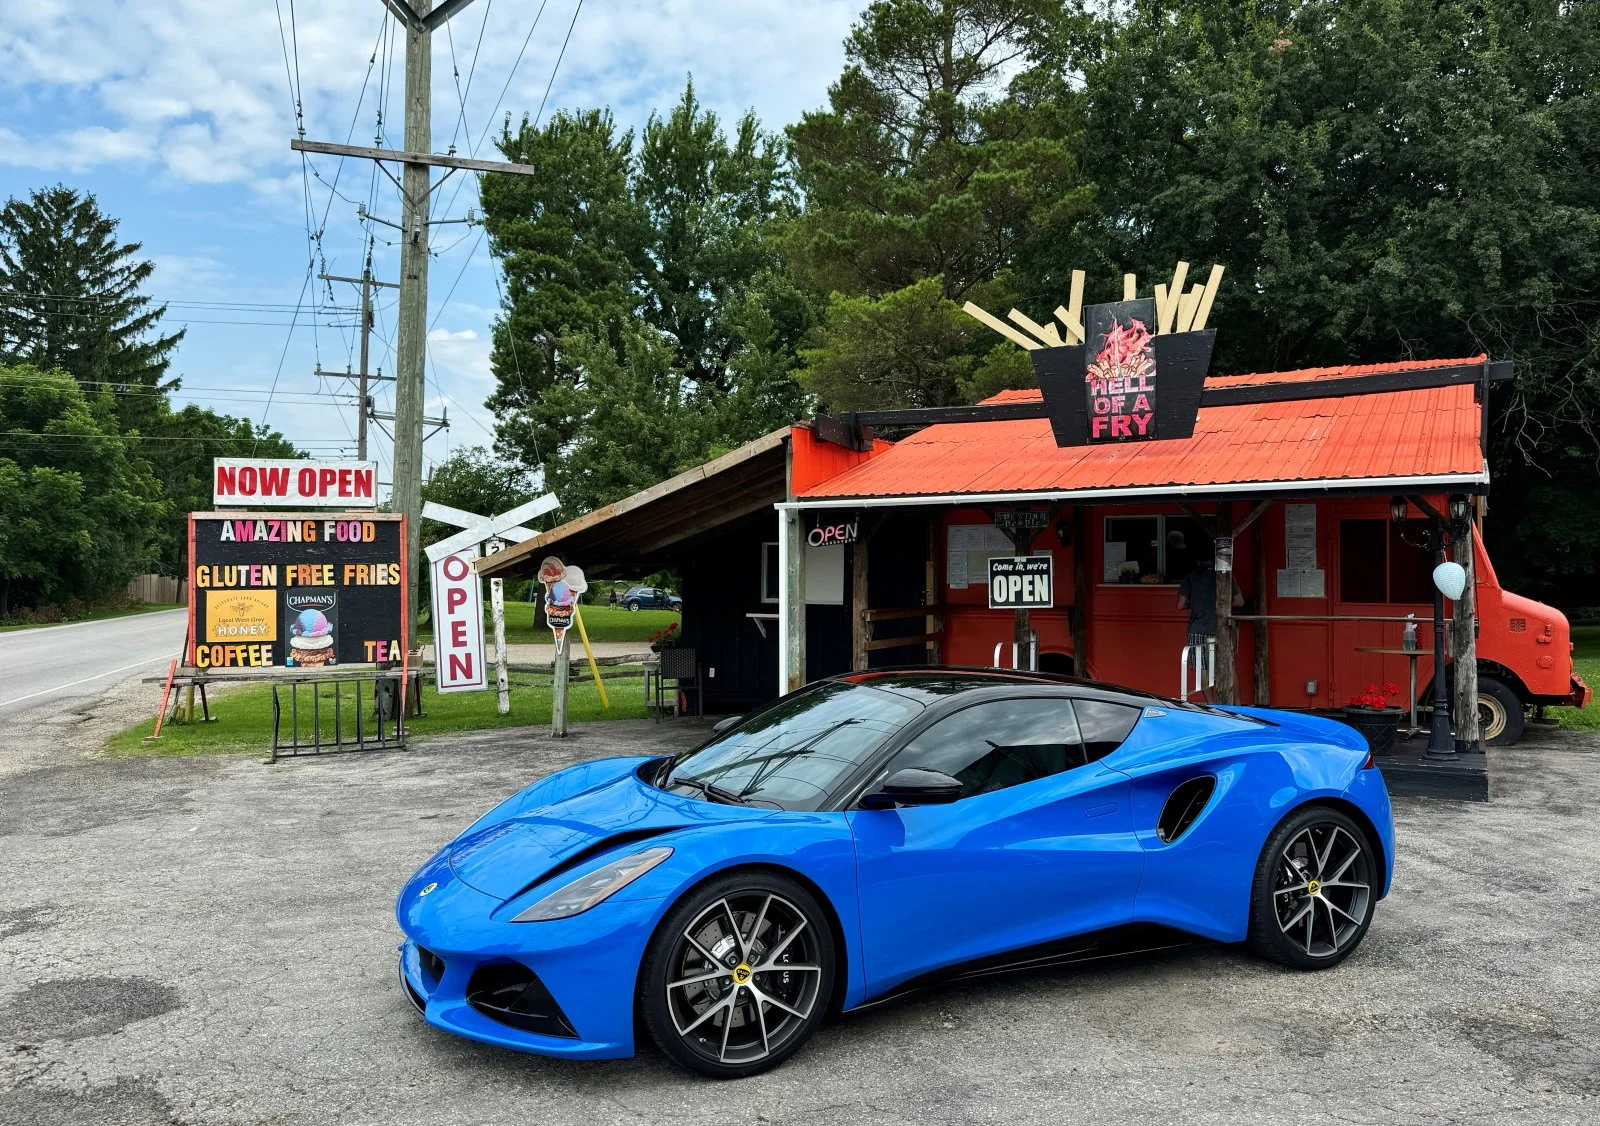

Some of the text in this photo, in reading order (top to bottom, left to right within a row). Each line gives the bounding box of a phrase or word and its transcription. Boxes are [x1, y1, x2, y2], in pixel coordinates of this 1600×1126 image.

[1091, 374, 1153, 396] HELL
[1093, 394, 1150, 414] OF A
[1092, 413, 1153, 438] FRY
[217, 466, 372, 498] NOW OPEN
[220, 520, 375, 542] AMAZING FOOD
[808, 522, 857, 546] OPEN
[196, 563, 401, 588] GLUTEN FREE FRIES
[992, 562, 1048, 571] Come in, we're
[289, 595, 333, 605] CHAPMAN'S
[993, 574, 1049, 603] OPEN
[218, 625, 266, 635] HONEY
[443, 555, 473, 681] OPEN
[196, 640, 402, 668] COFFEE TEA
